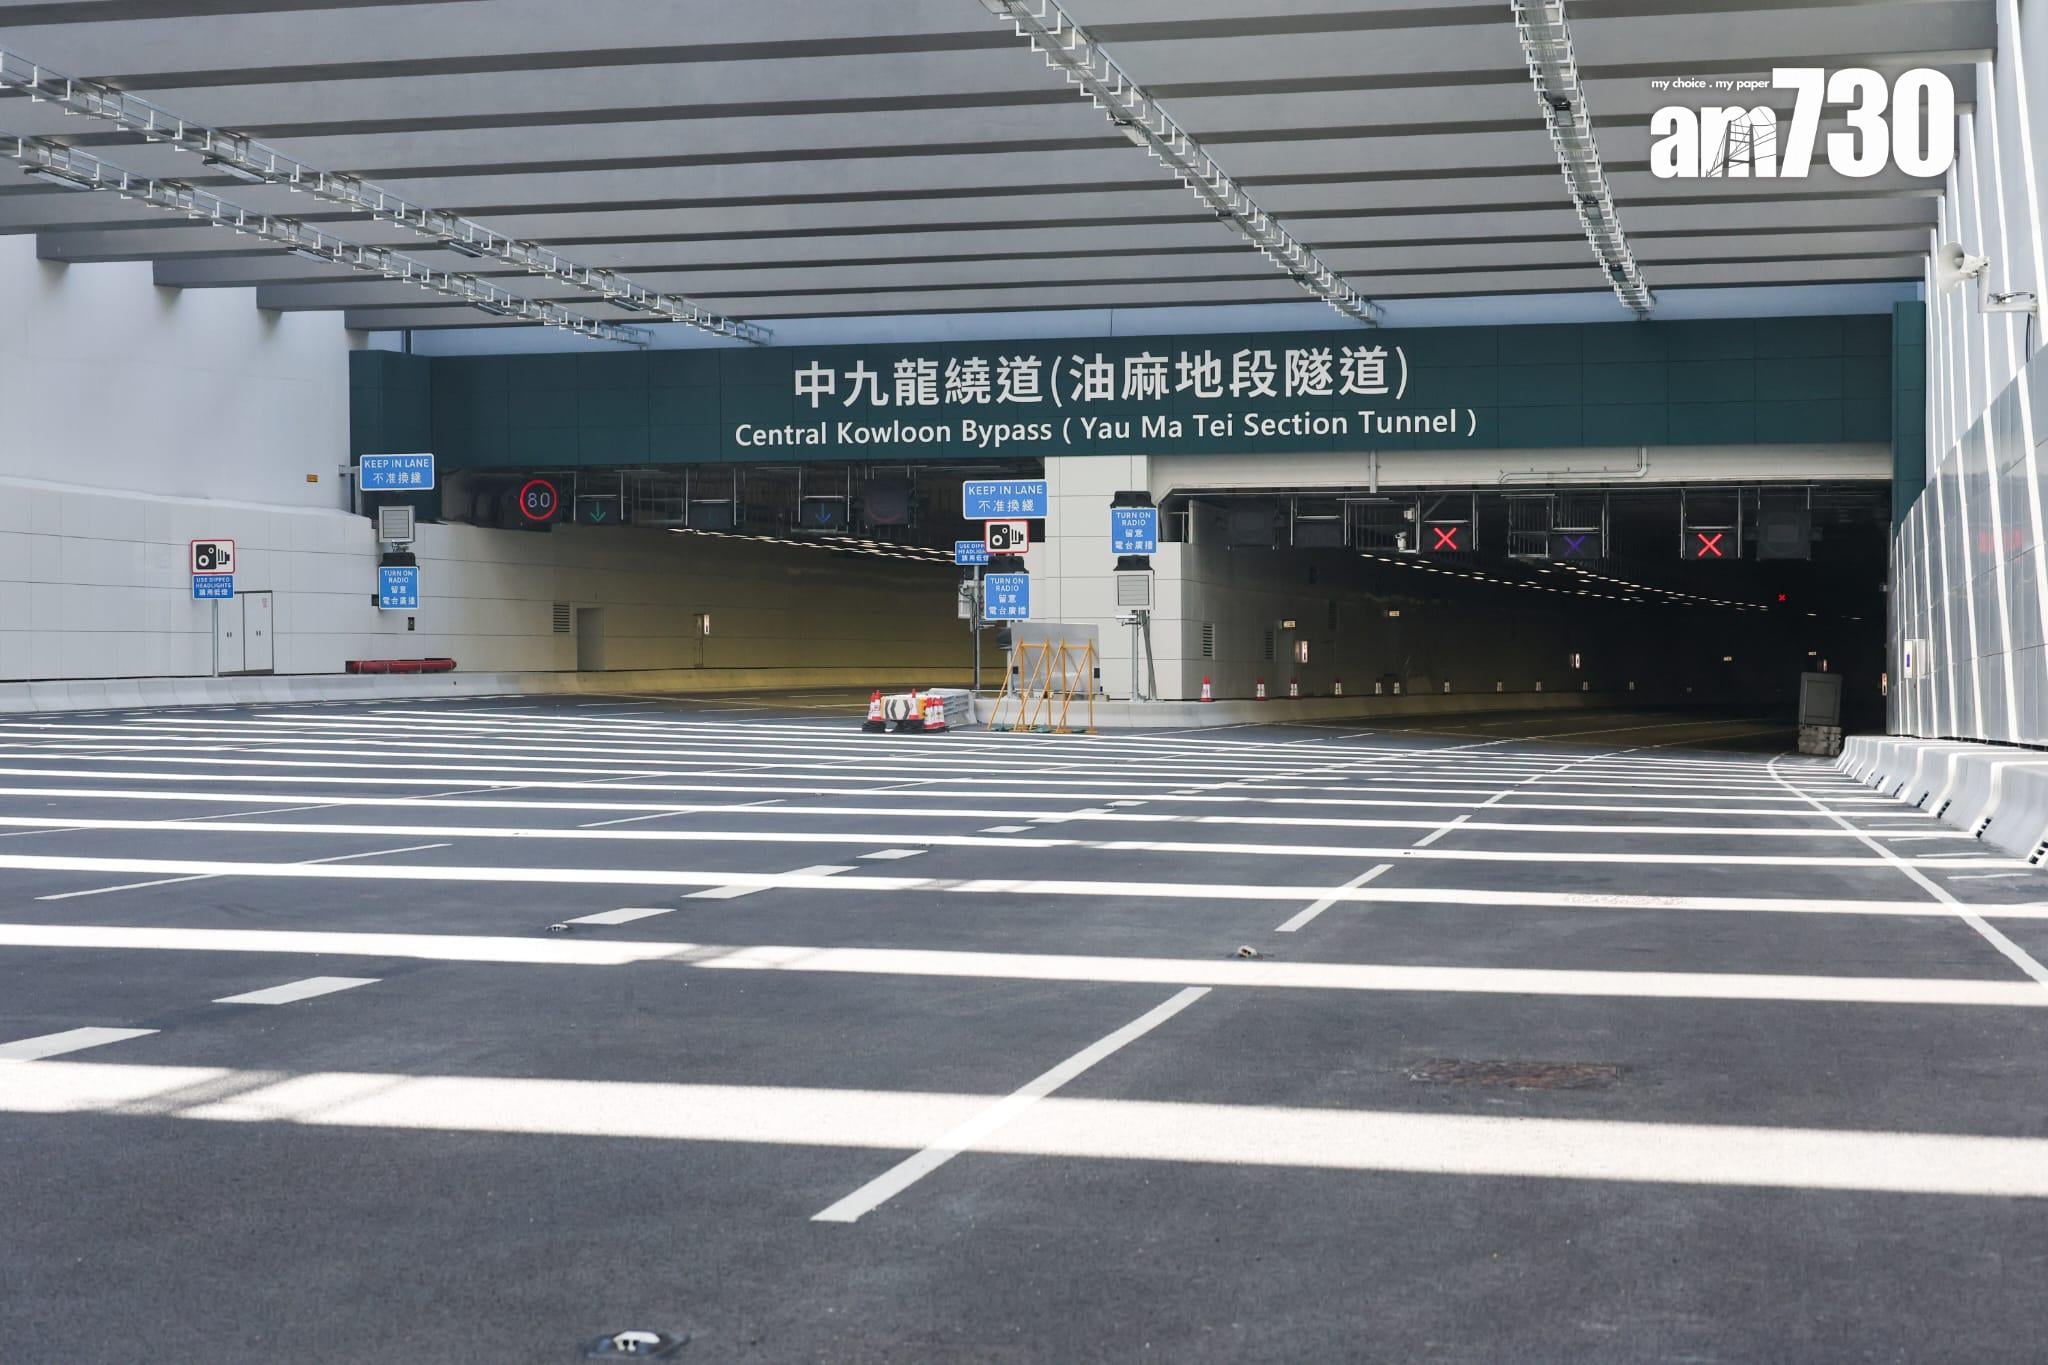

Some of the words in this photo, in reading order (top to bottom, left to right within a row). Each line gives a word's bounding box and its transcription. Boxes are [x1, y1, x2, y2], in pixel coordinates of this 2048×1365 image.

[794, 345, 1407, 408] 中九龍繞道(油麻地段隧道)
[735, 422, 826, 447] Central
[837, 420, 951, 444] Kowloon
[961, 418, 1052, 448] Bypass
[1080, 416, 1130, 439] Yau
[1141, 414, 1182, 438] Ma
[1193, 413, 1234, 437] Tei
[1244, 411, 1348, 436] Section
[1358, 409, 1456, 433] Tunnel
[364, 460, 388, 468] KEEP
[391, 460, 402, 468] IN
[405, 459, 429, 468] LANE
[968, 486, 996, 495] KEEP
[999, 486, 1012, 494] IN
[1015, 485, 1043, 494] LANE
[528, 492, 550, 508] 80
